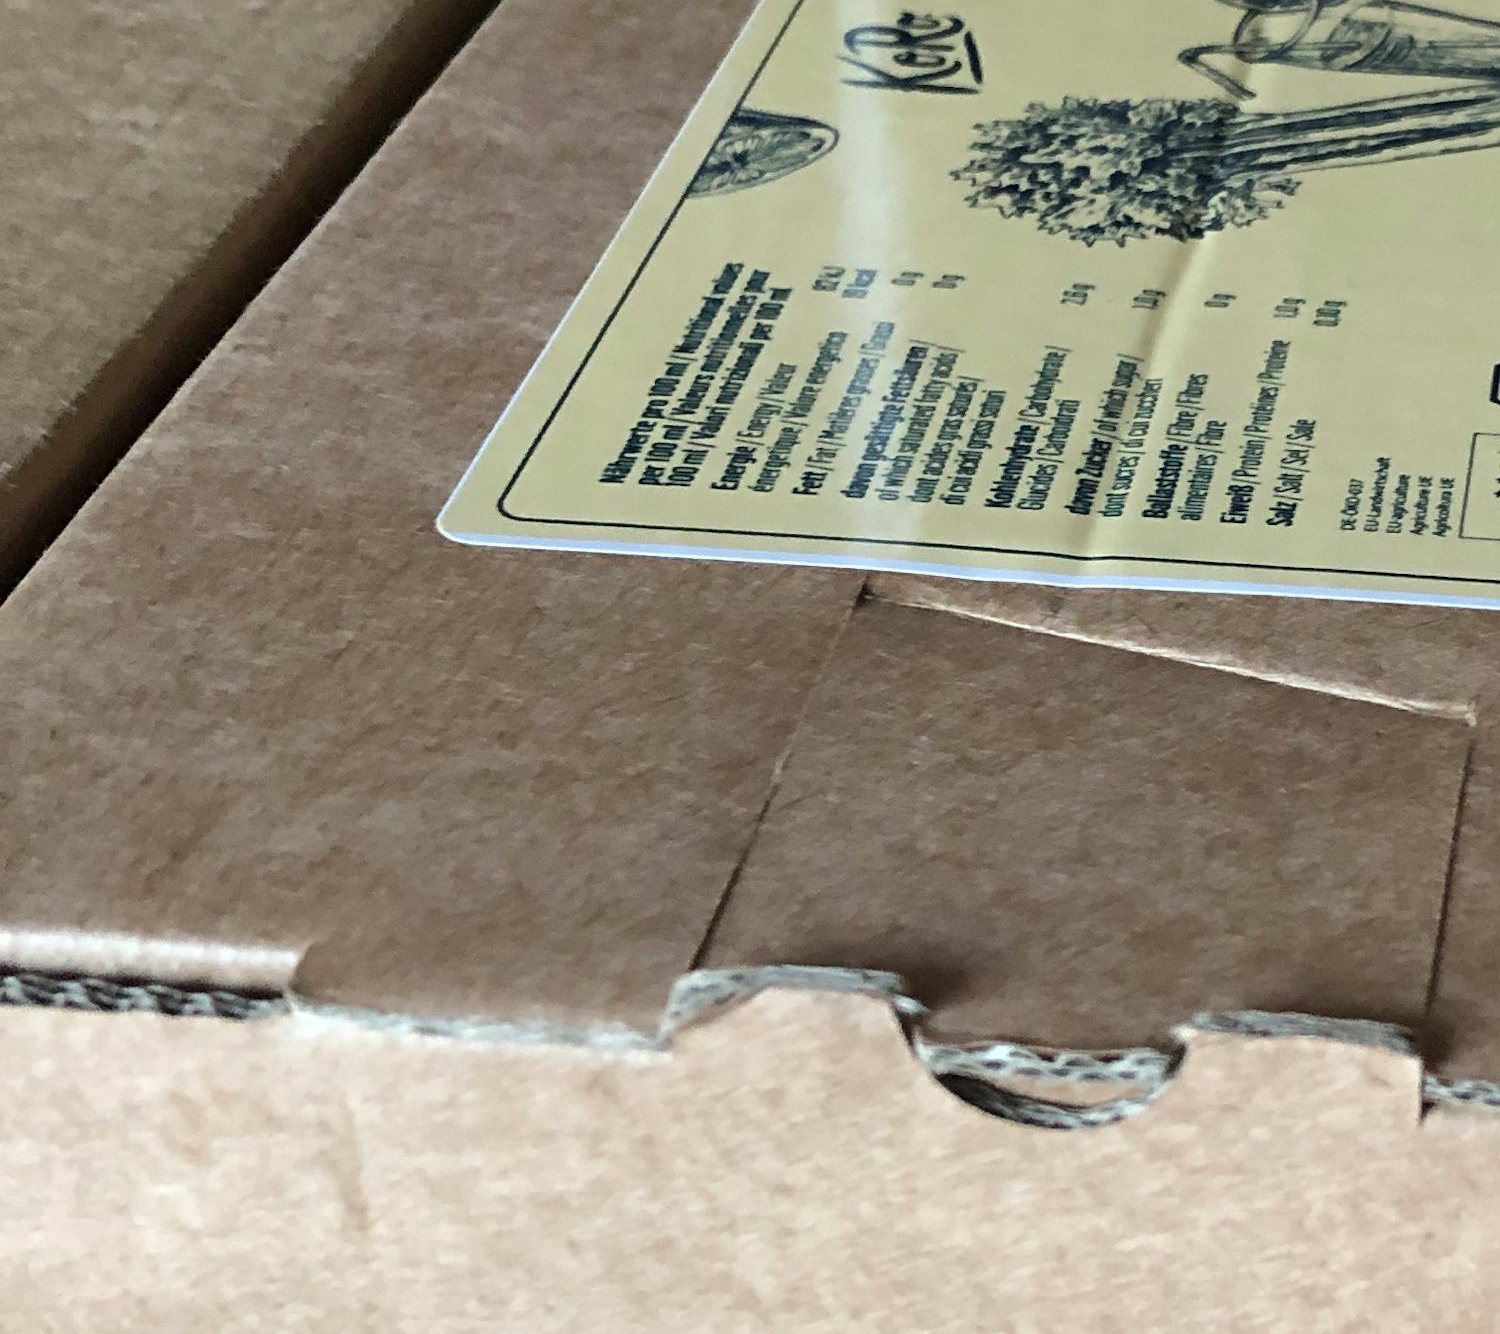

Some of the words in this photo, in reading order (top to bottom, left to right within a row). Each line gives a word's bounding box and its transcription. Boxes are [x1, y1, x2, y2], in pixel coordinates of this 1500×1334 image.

[664, 361, 690, 377] ml
[930, 352, 959, 379] acids
[648, 377, 681, 397] 100
[668, 373, 716, 416] Valeurs
[912, 378, 953, 404] fatty
[1175, 373, 1209, 405] Fibres
[640, 399, 670, 419] pro
[781, 385, 822, 419] Valore
[978, 389, 1007, 419] saturi
[1098, 388, 1130, 419] which
[1231, 439, 1266, 478] Protein
[1256, 339, 1292, 380] Proteine
[662, 424, 689, 441] ml
[688, 405, 732, 440] Valori
[897, 404, 937, 454] saturated
[936, 418, 964, 441] gras
[966, 418, 996, 450] grassi
[983, 424, 1040, 509] Kohlenhydrate
[1017, 351, 1068, 418] Carbohydrate
[1092, 418, 1120, 432] of
[1125, 420, 1150, 437] cui
[1166, 410, 1199, 437] Fibre
[1193, 420, 1228, 447] Fibre
[1285, 419, 1317, 442] Sale
[598, 420, 658, 484] Nährwerte
[644, 442, 679, 463] 100
[681, 449, 710, 465] ml
[710, 445, 758, 491] Energie
[736, 402, 784, 439] Energy
[806, 447, 839, 464] Fat
[1120, 438, 1145, 449] di
[1280, 448, 1310, 466] Sel
[881, 455, 915, 487] which
[920, 441, 955, 477] acides
[954, 449, 984, 476] acidi
[1074, 437, 1114, 478] Zucker
[638, 464, 666, 487] per
[660, 465, 700, 487] 100
[791, 471, 828, 496] Fett
[839, 463, 878, 499] davon
[946, 475, 973, 493] cui
[1110, 455, 1141, 491] sucres
[1141, 443, 1189, 519] Ballaststoffe
[1273, 473, 1305, 494] Salt
[1417, 475, 1433, 488] UE
[1439, 477, 1456, 489] UE
[874, 487, 900, 501] of
[906, 477, 941, 503] dont
[938, 493, 966, 506] di
[1014, 463, 1059, 511] Glucides
[1063, 477, 1101, 516] davon
[1176, 453, 1218, 521] alimentaires
[1362, 457, 1391, 533] EU-Landwirtschaft
[1096, 492, 1130, 517] dont
[1265, 501, 1298, 527] Salz
[1408, 488, 1432, 536] Agriculture
[1431, 490, 1453, 537] Agricoltura
